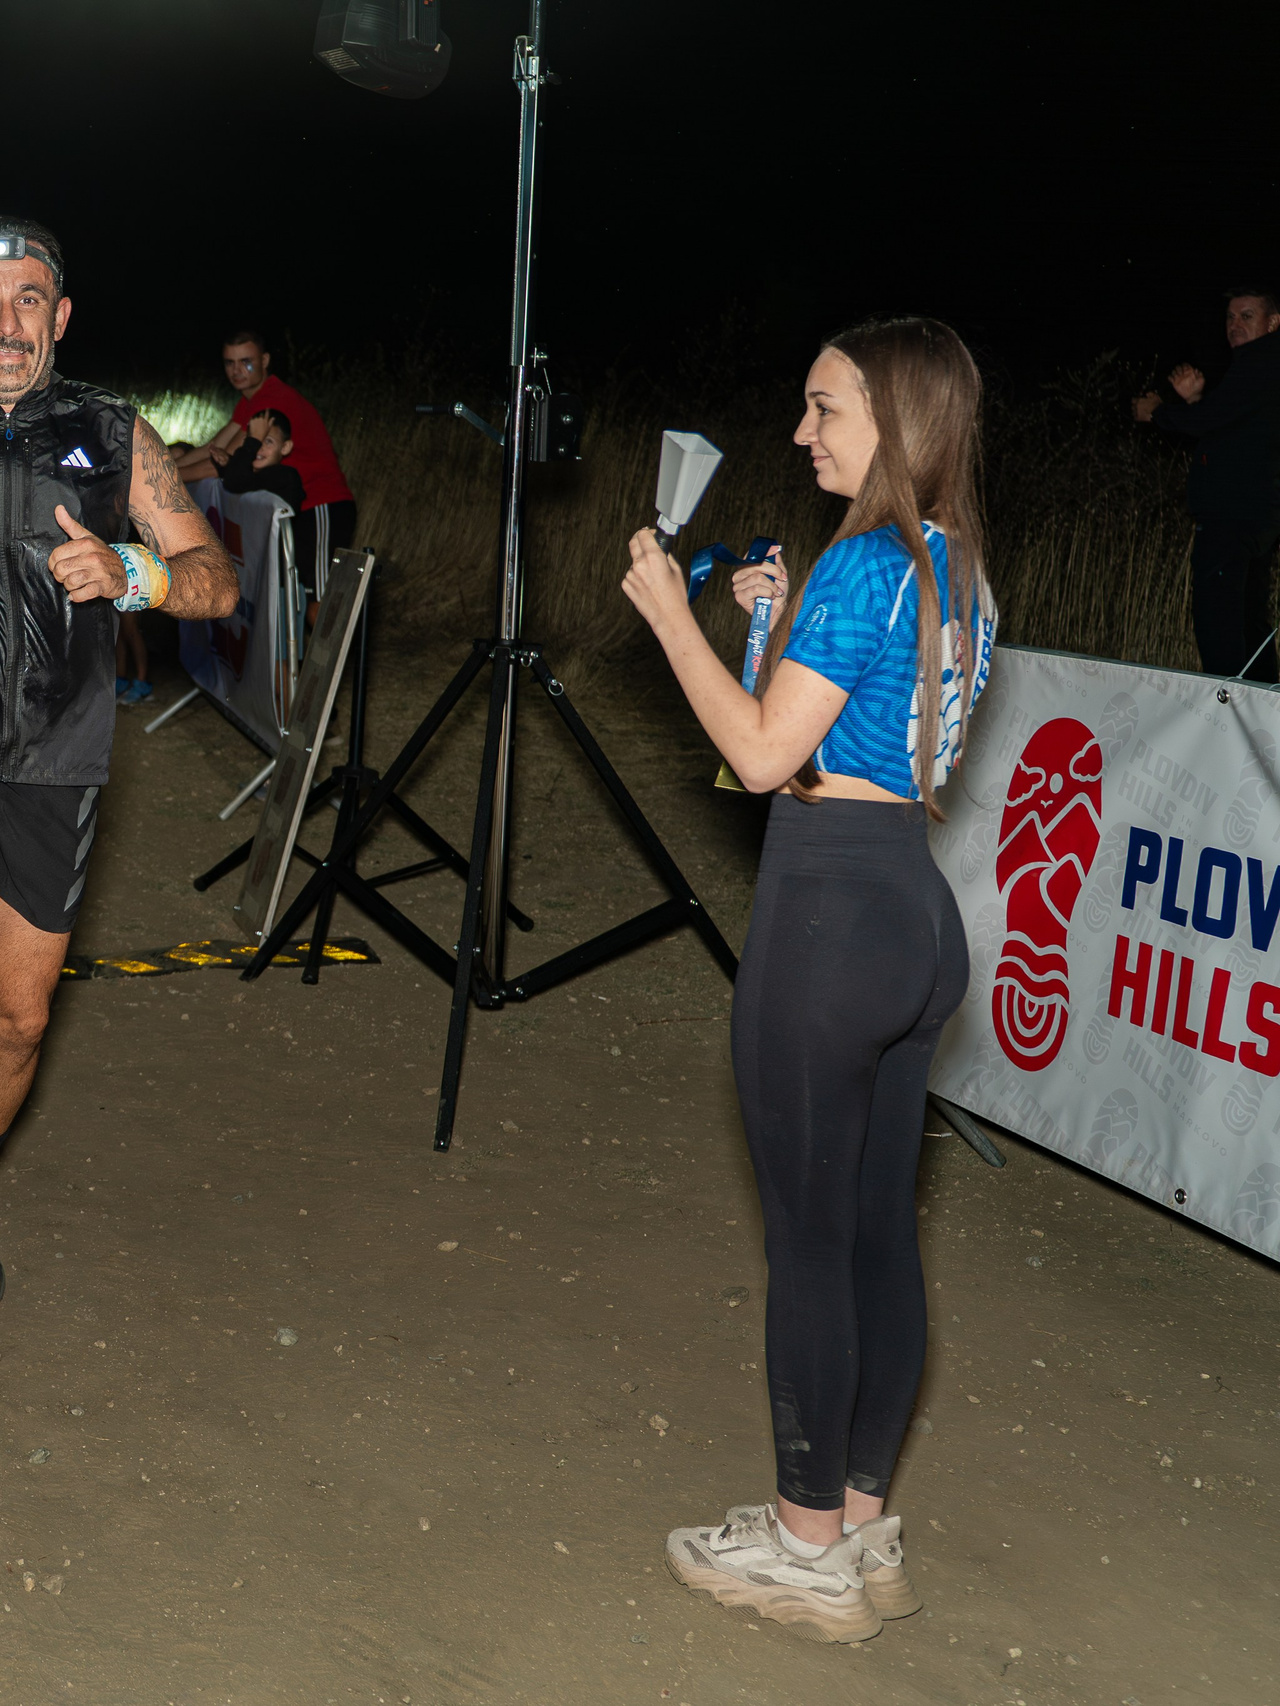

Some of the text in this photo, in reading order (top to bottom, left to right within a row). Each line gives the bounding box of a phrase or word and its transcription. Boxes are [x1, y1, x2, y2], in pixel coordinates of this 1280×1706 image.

[748, 629, 765, 656] Night
[1120, 769, 1177, 829] HILLS
[1128, 737, 1220, 816] PLOVDIV
[1120, 825, 1280, 953] PLOV
[1107, 934, 1280, 1077] HILLS
[1122, 1037, 1175, 1104] HILLS
[1172, 1101, 1228, 1157] MARKOVO
